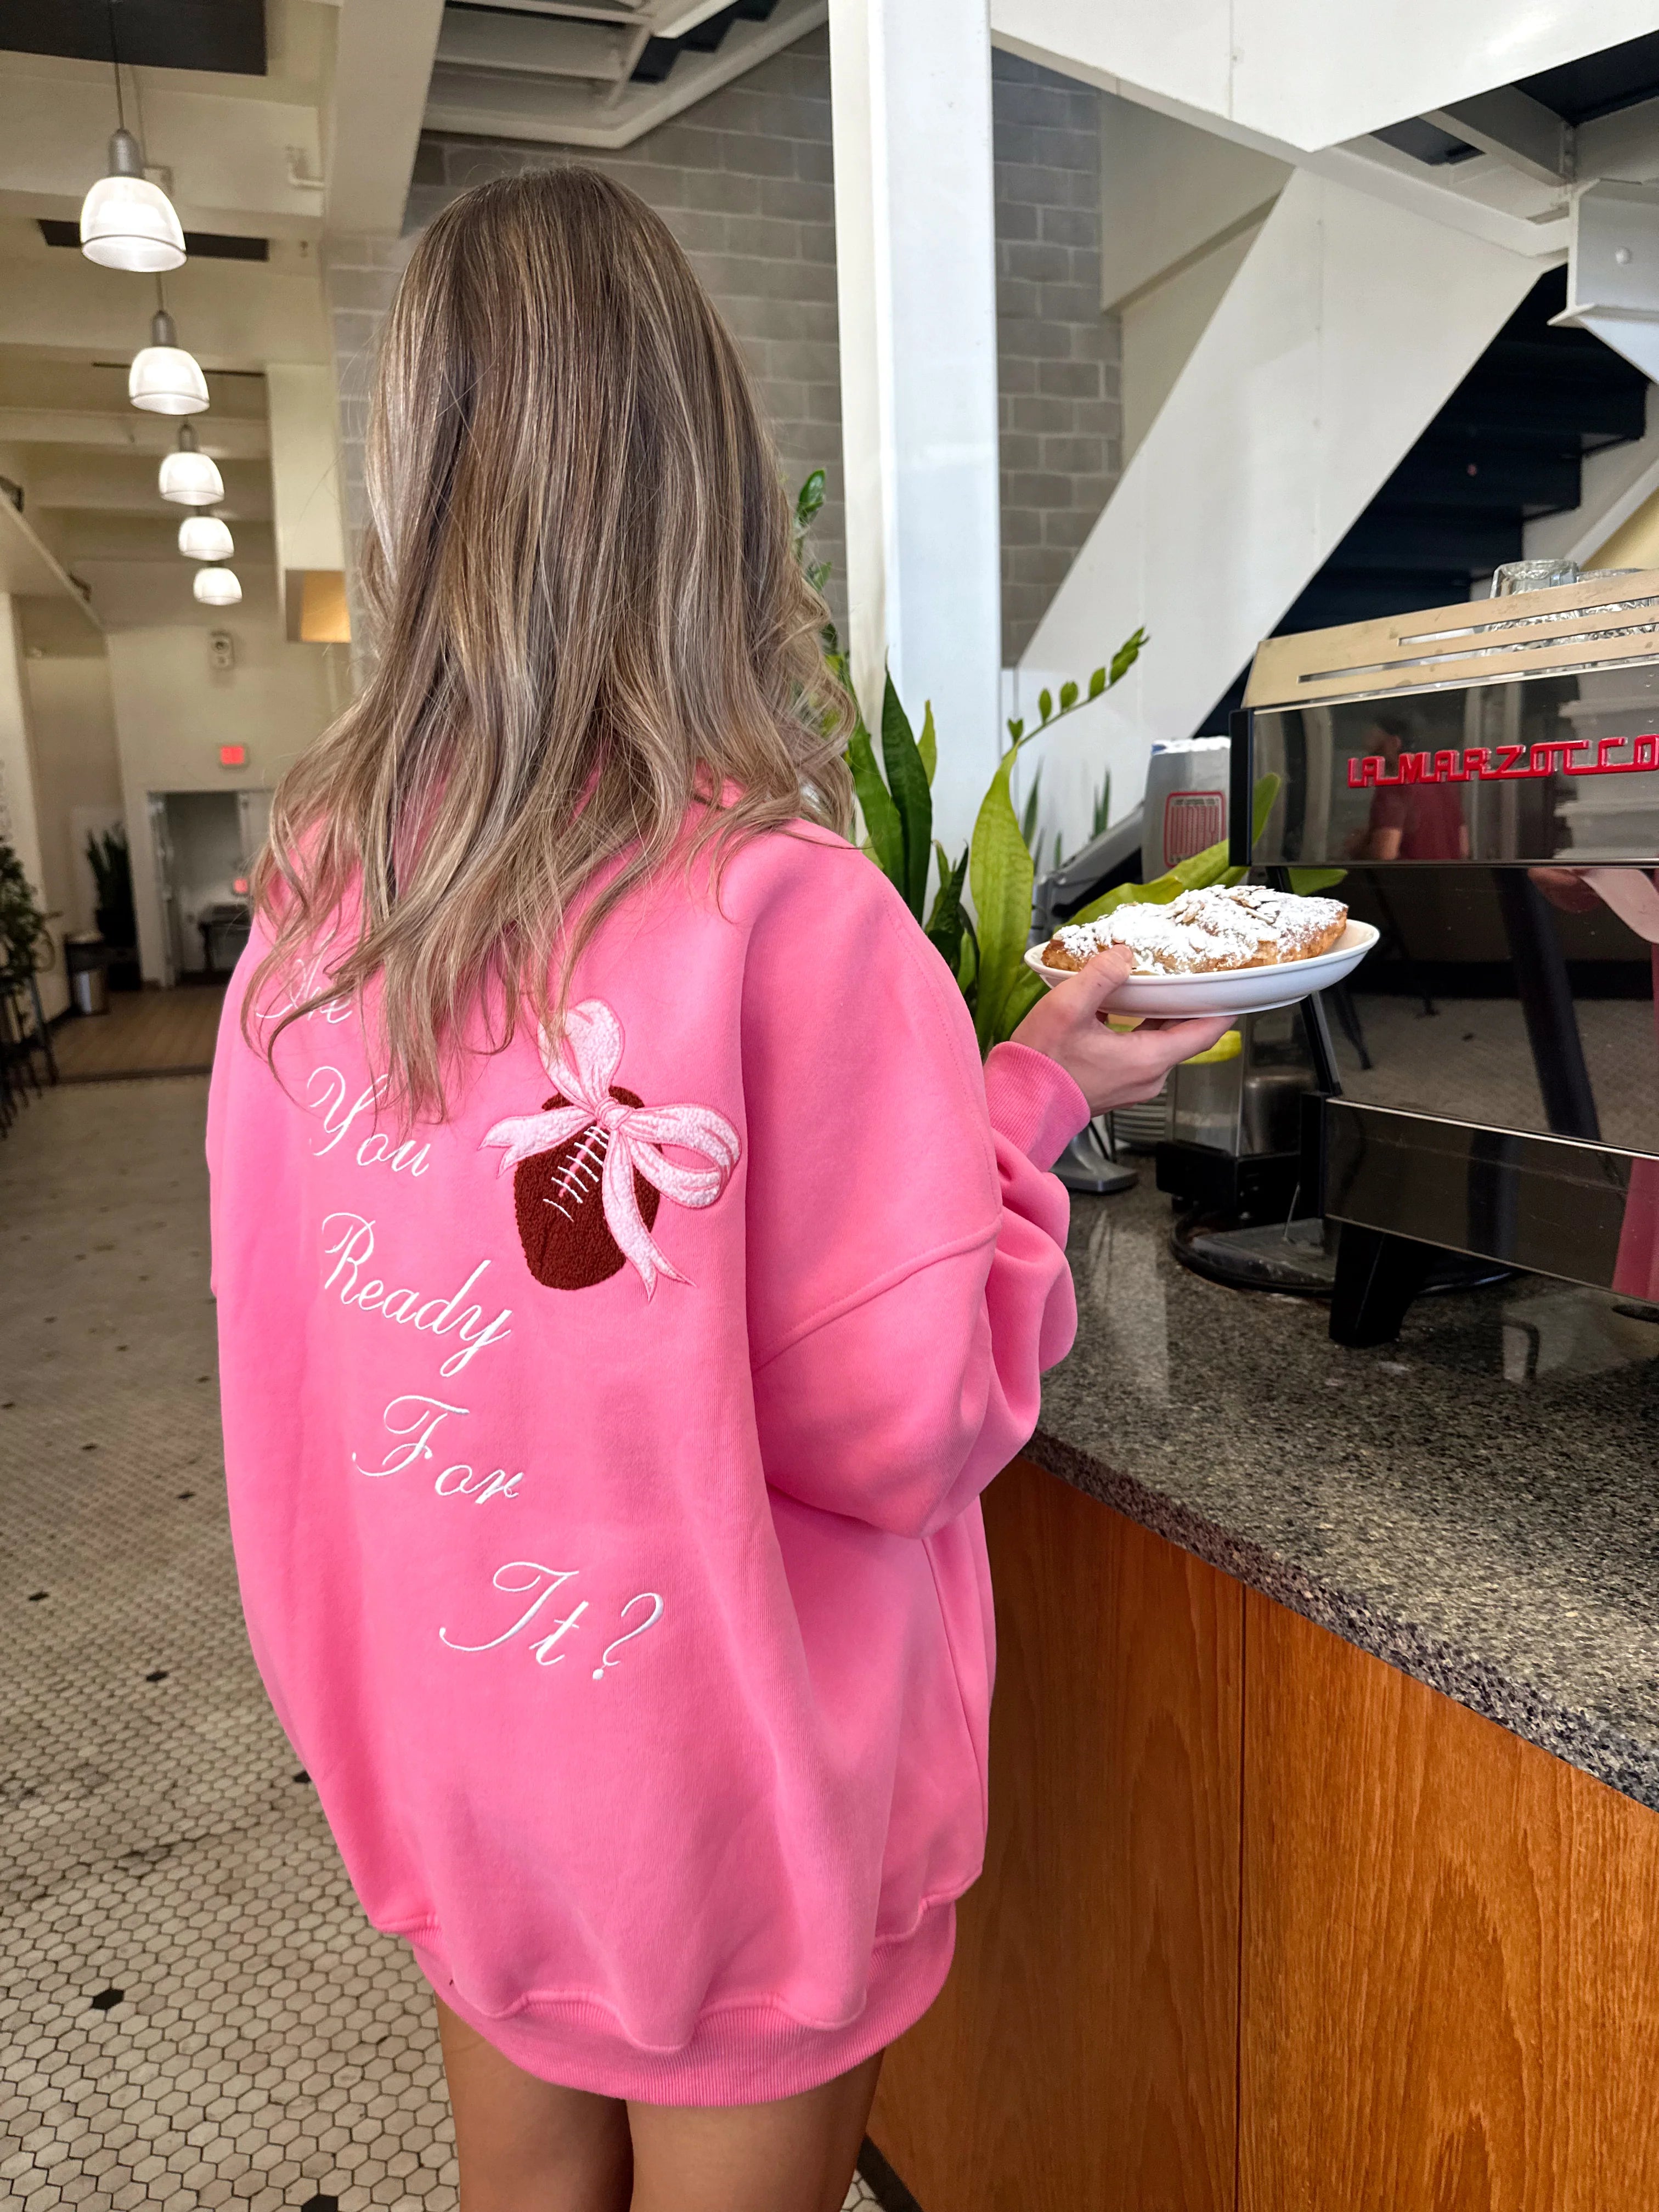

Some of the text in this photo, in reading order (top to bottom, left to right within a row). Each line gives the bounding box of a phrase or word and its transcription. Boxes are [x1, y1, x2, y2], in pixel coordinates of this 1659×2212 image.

[307, 1065, 431, 1177] You
[321, 1212, 512, 1378] Ready
[352, 1395, 524, 1504] For
